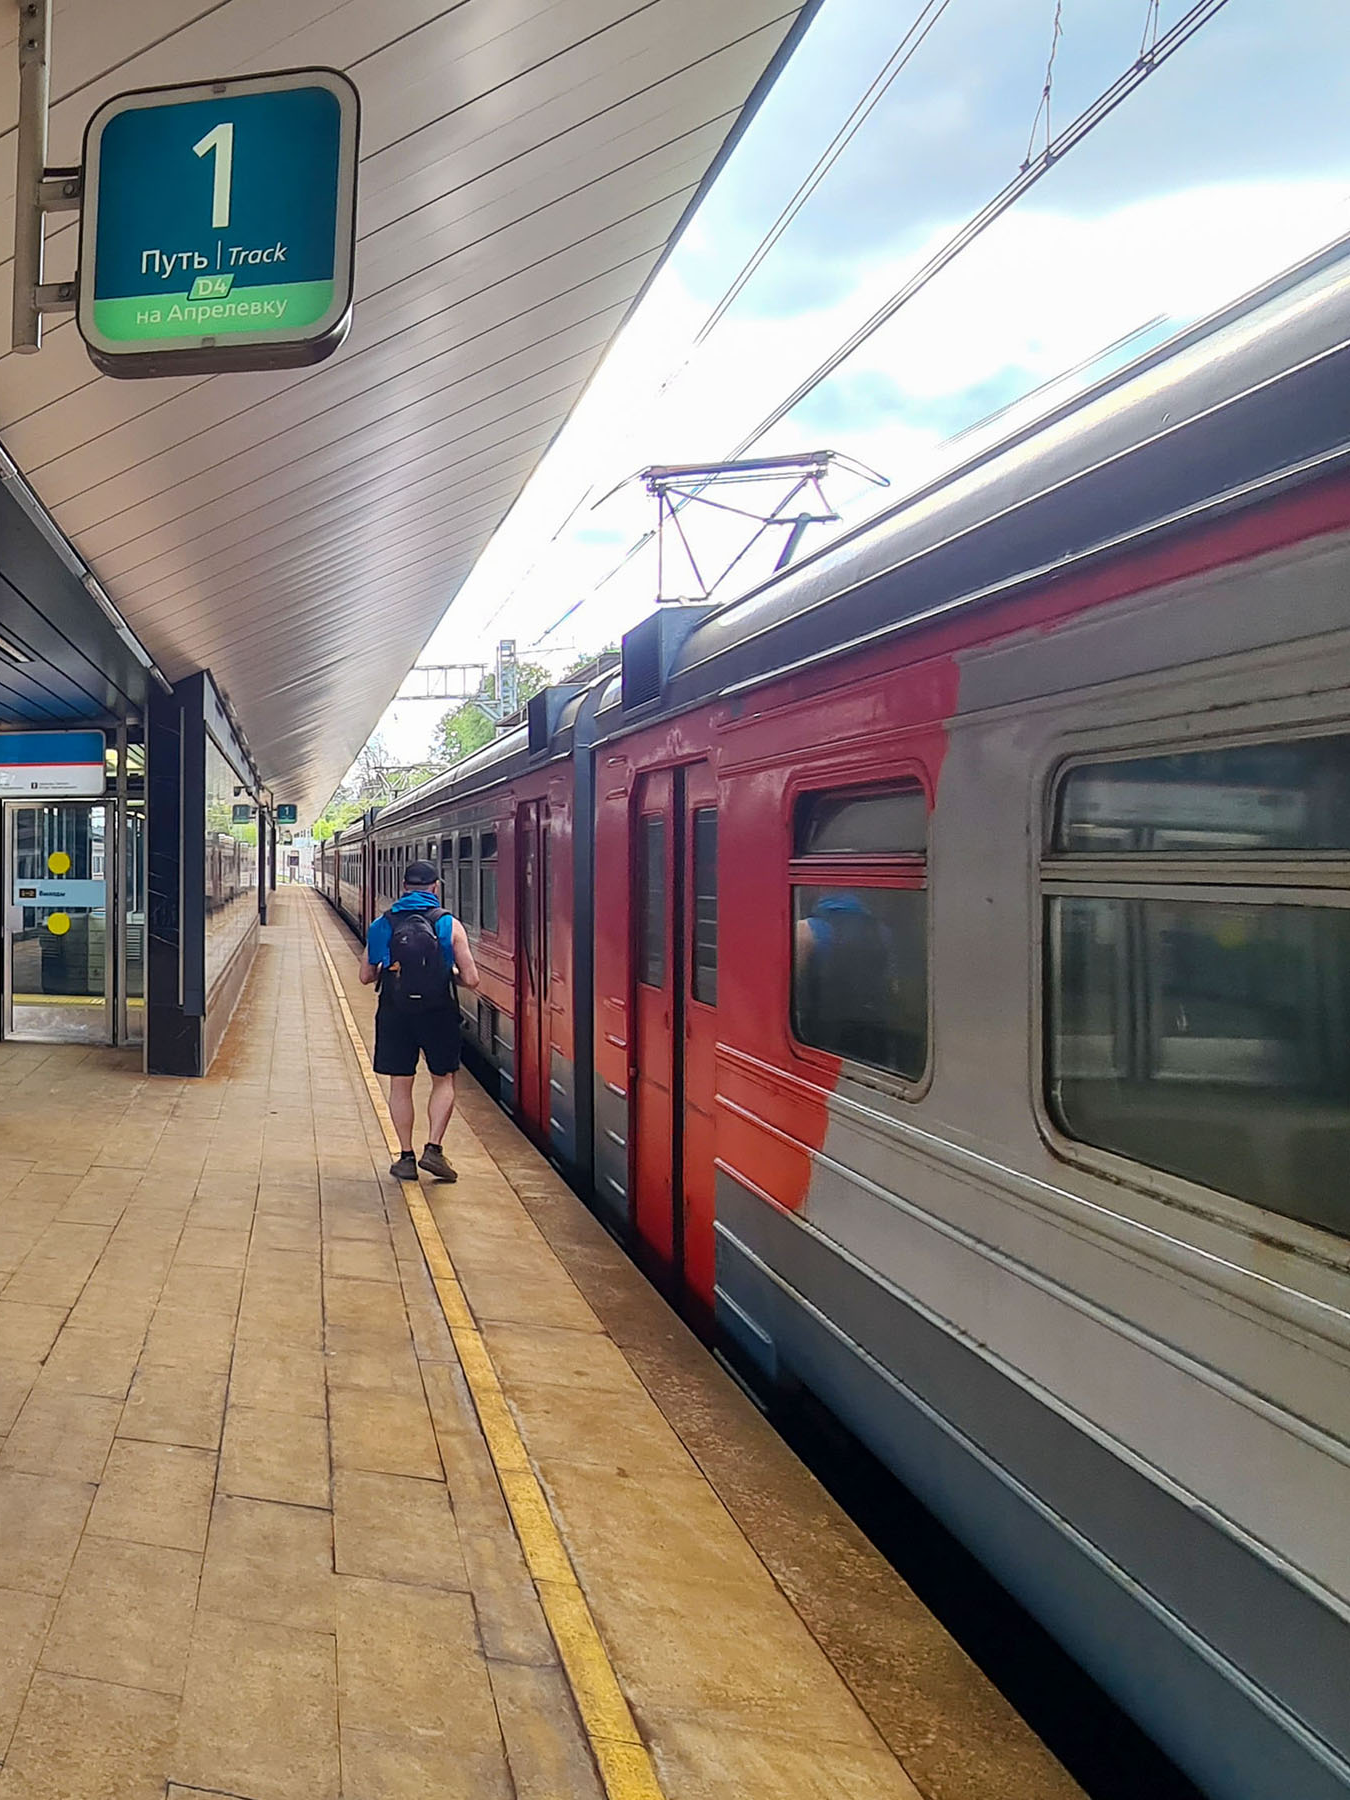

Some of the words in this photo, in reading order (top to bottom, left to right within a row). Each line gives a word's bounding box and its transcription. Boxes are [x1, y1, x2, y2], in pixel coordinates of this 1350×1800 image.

[192, 122, 234, 229] 1
[141, 249, 209, 279] Путь
[228, 242, 288, 266] Track
[198, 278, 228, 296] D4
[136, 310, 161, 325] на
[167, 299, 288, 324] Апрелевку
